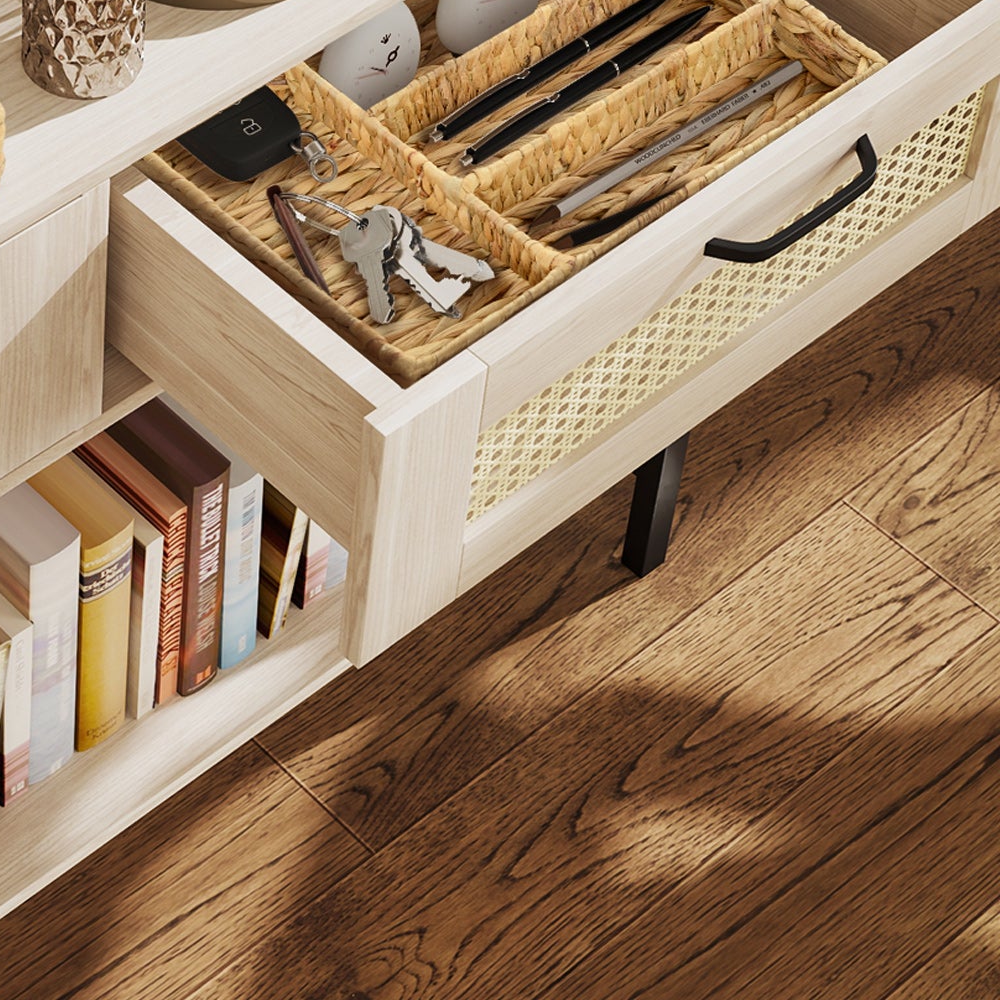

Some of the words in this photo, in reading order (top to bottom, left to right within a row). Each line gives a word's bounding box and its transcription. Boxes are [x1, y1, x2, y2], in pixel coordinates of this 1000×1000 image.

[202, 483, 223, 513] THE
[200, 504, 222, 550] BULLET
[198, 542, 220, 584] TRICK
